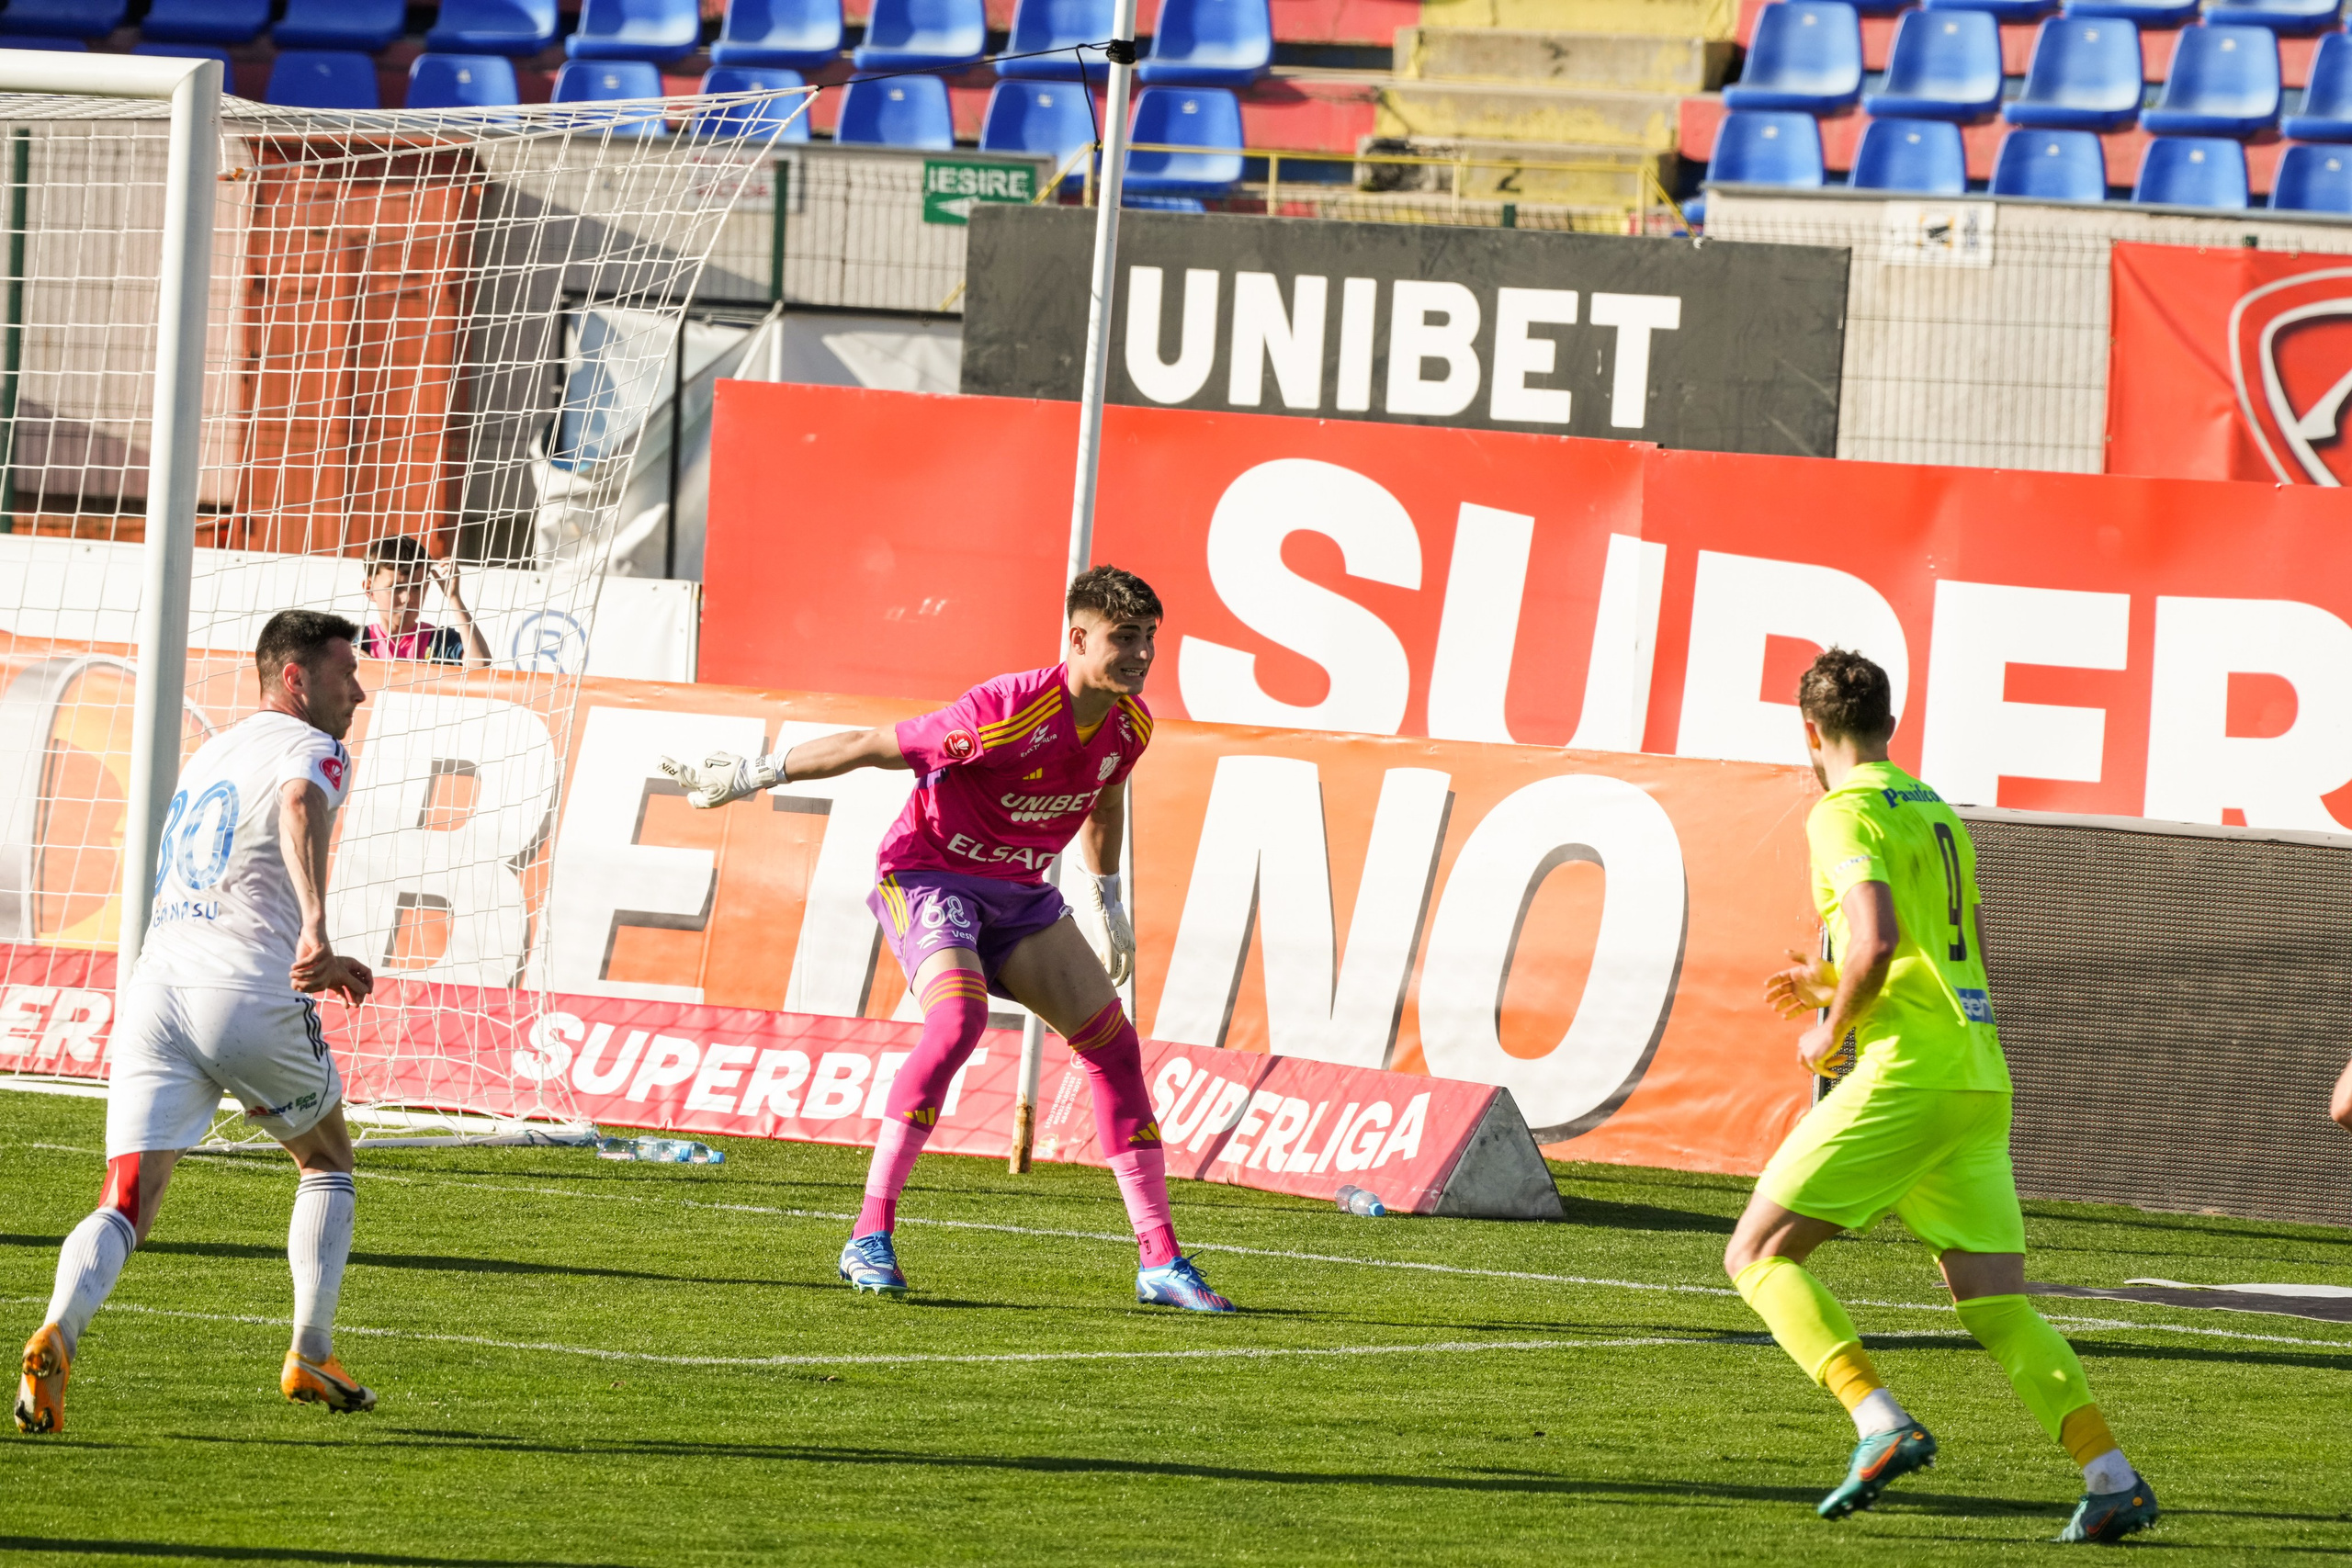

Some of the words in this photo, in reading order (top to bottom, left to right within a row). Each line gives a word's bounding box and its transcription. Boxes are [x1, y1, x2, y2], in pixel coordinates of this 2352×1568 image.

[1125, 265, 1682, 429] UNIBET
[1001, 787, 1102, 812] UNIBET
[922, 895, 971, 929] 68
[1934, 822, 1966, 961] 9
[295, 1091, 317, 1108] Eco
[513, 1011, 989, 1120] SUPERBET
[1149, 1056, 1431, 1173] SUPERLIGA
